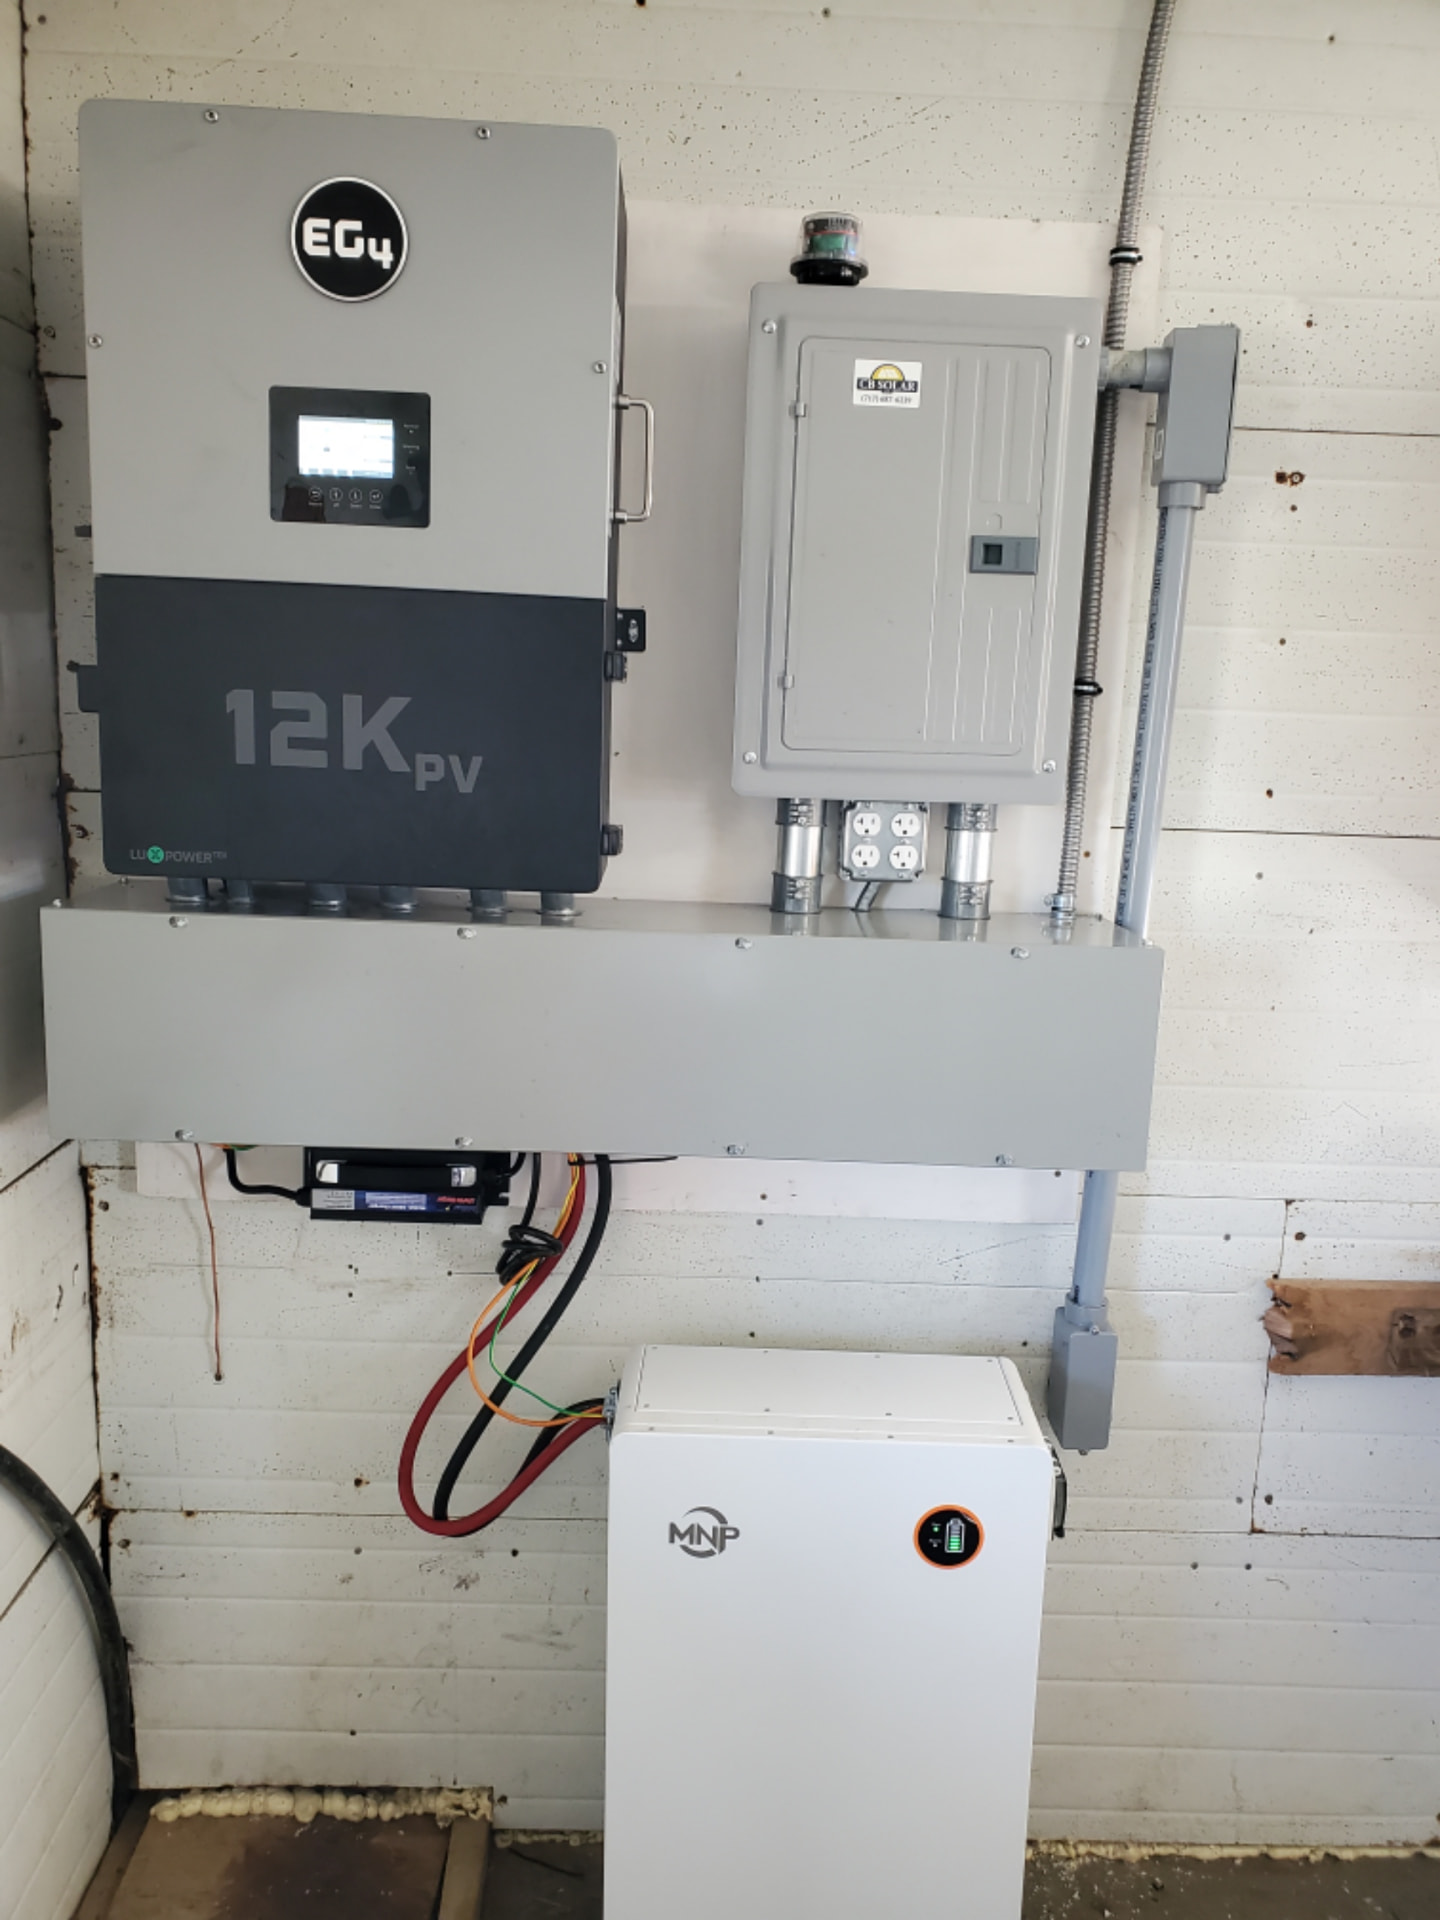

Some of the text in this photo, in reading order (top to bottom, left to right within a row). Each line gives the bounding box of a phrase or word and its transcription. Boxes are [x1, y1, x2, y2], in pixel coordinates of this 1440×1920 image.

[302, 217, 393, 270] EG4
[877, 379, 916, 392] SOLAR
[669, 1522, 740, 1555] MNP
